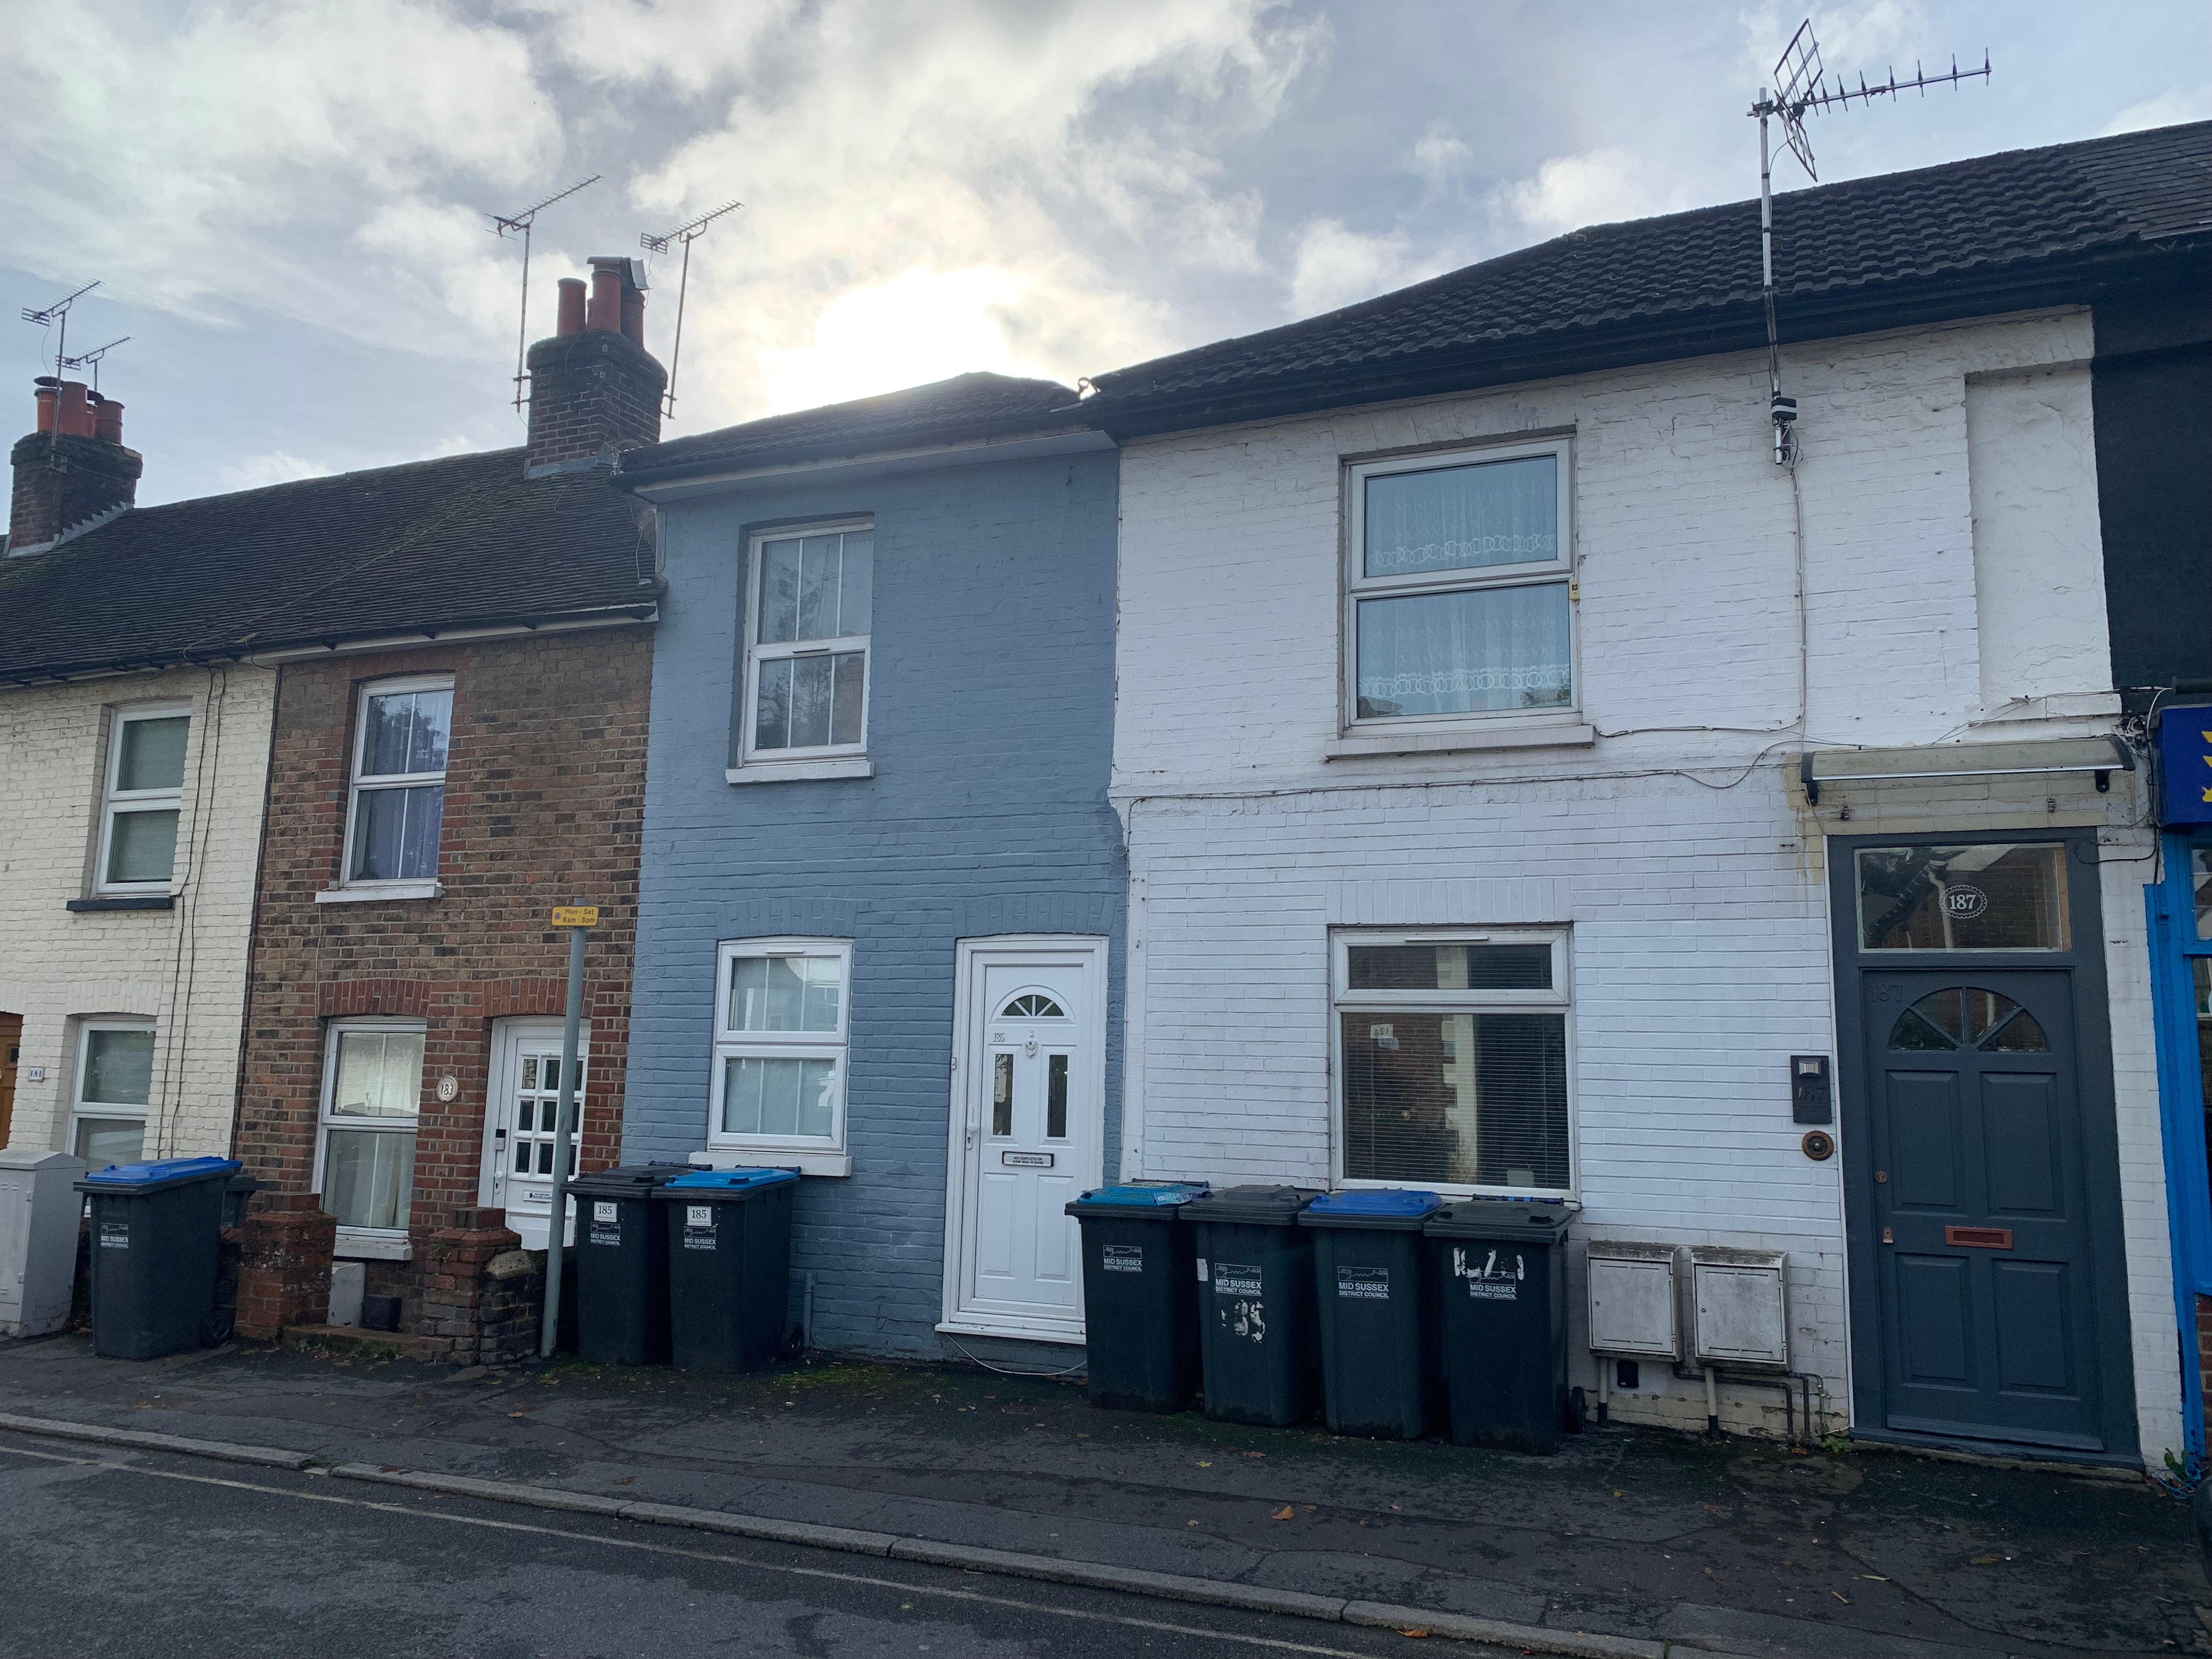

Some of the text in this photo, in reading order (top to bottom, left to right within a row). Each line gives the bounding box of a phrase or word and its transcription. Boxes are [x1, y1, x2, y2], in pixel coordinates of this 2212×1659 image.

[1949, 894, 1976, 910] 187
[993, 1032, 1005, 1042] 185
[441, 1084, 453, 1095] 183
[599, 1206, 612, 1214] 185
[692, 1210, 706, 1218] 185
[1230, 1280, 1262, 1289] SUSSEX
[1355, 1283, 1389, 1291] SUSSEX
[1485, 1285, 1516, 1293] SUSSEX
